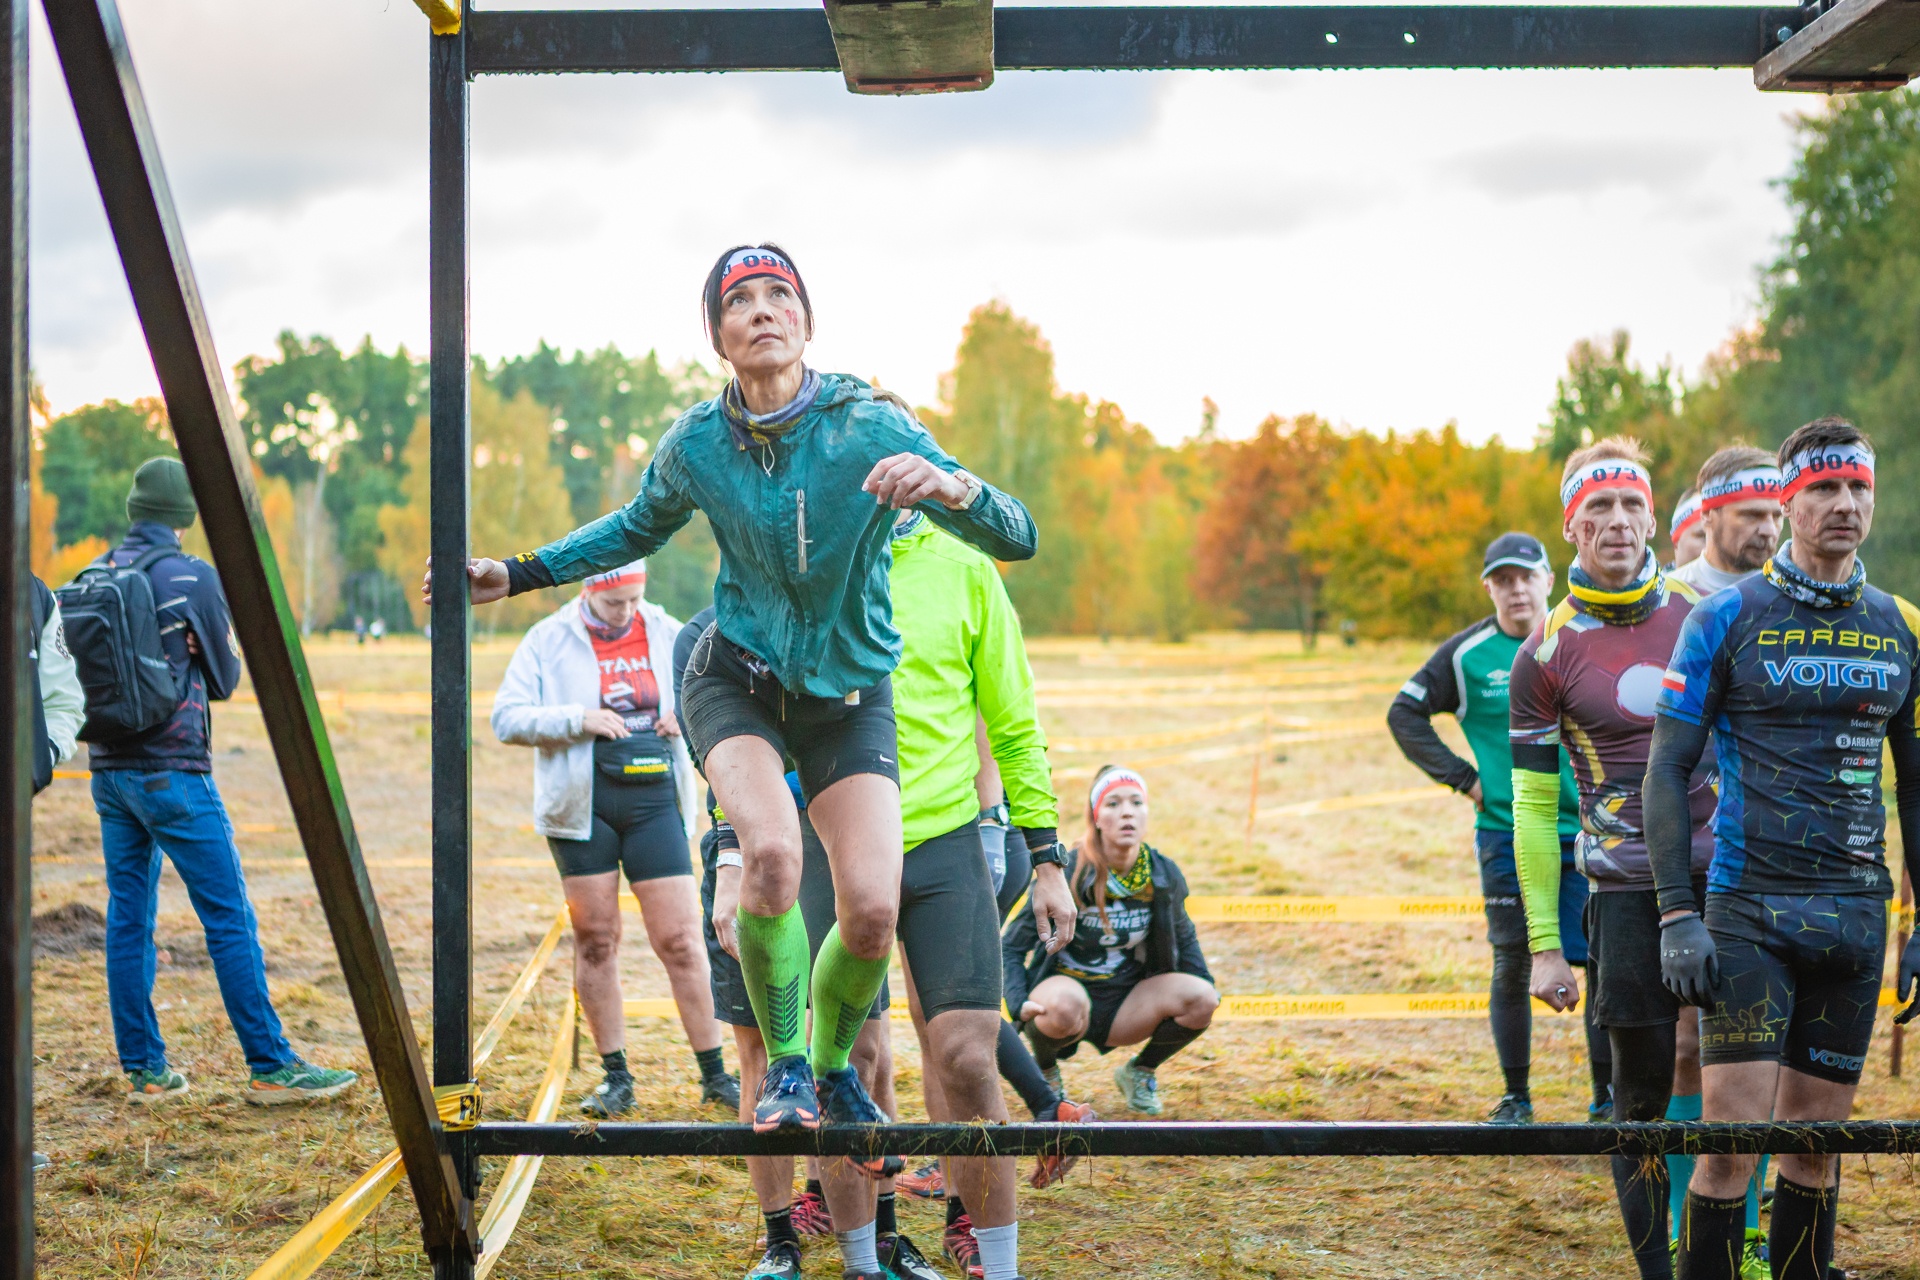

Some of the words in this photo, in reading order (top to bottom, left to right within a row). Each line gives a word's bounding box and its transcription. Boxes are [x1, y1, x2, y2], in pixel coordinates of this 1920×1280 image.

[1810, 453, 1859, 473] 004
[1592, 466, 1638, 483] 073
[1757, 629, 1899, 654] CARBON
[1763, 656, 1890, 692] VOIGT
[1700, 1032, 1776, 1046] ARBON
